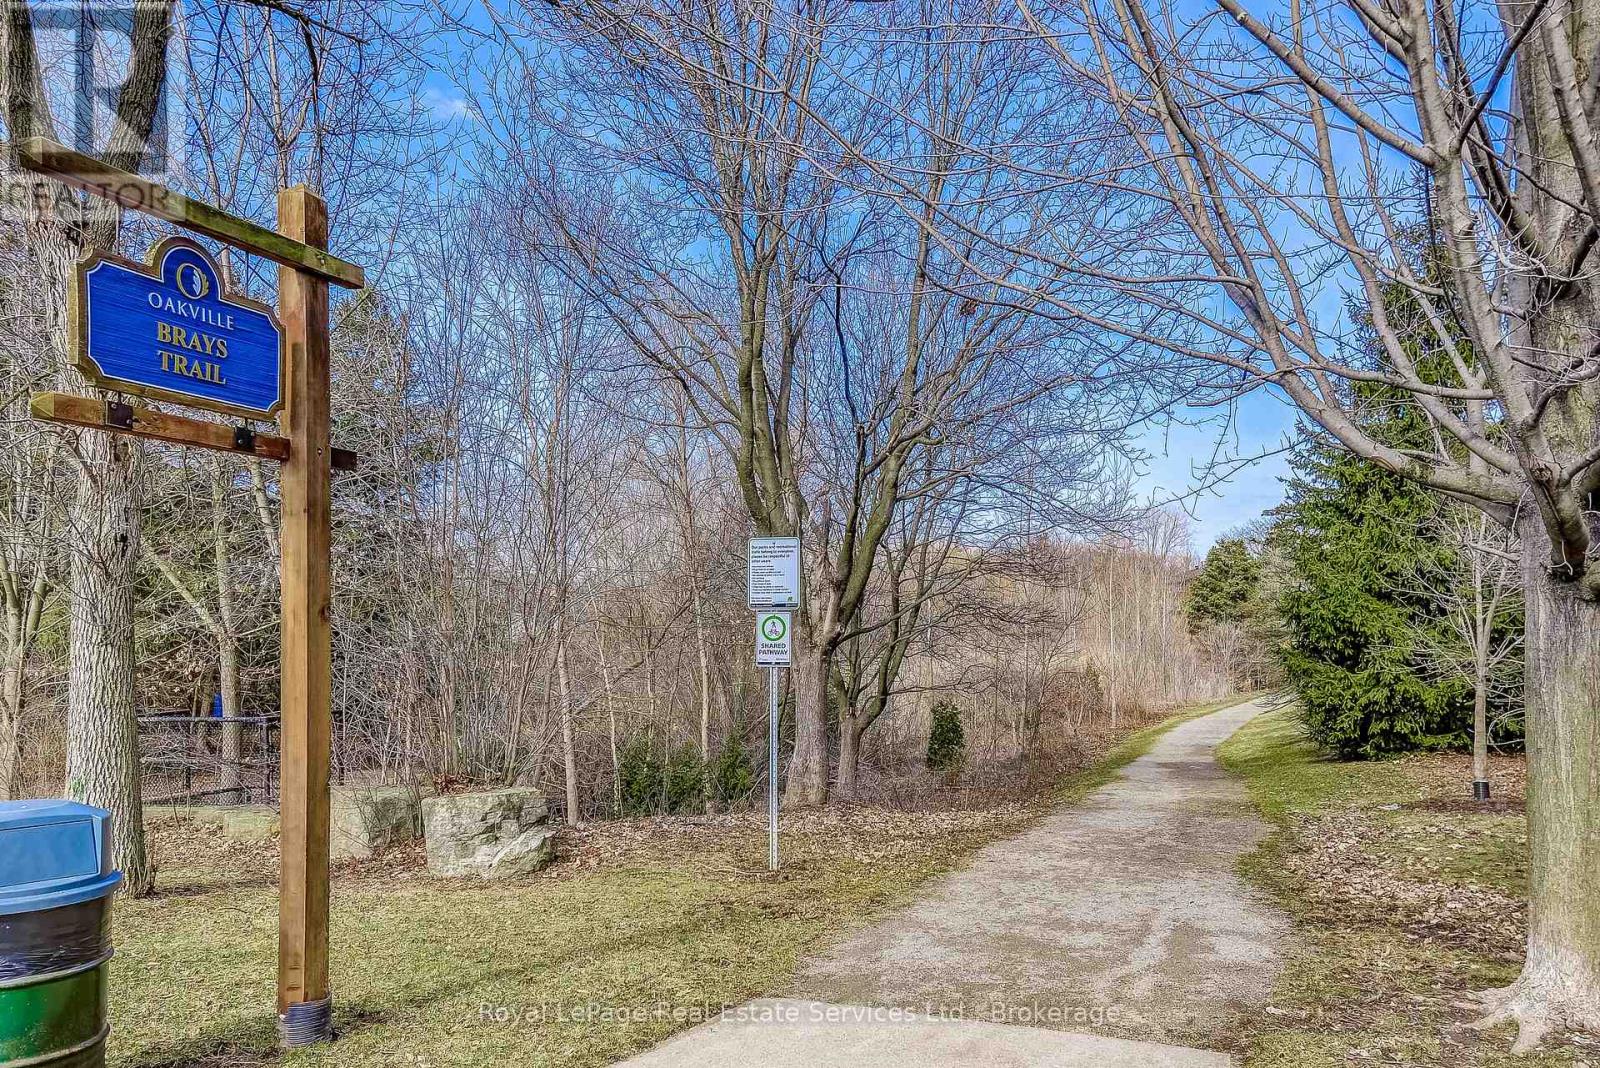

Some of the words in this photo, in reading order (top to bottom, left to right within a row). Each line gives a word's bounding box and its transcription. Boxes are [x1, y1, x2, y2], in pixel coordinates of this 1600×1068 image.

[147, 291, 235, 330] OAKVILLE
[156, 321, 228, 359] BRAYS
[157, 350, 227, 385] TRAIL
